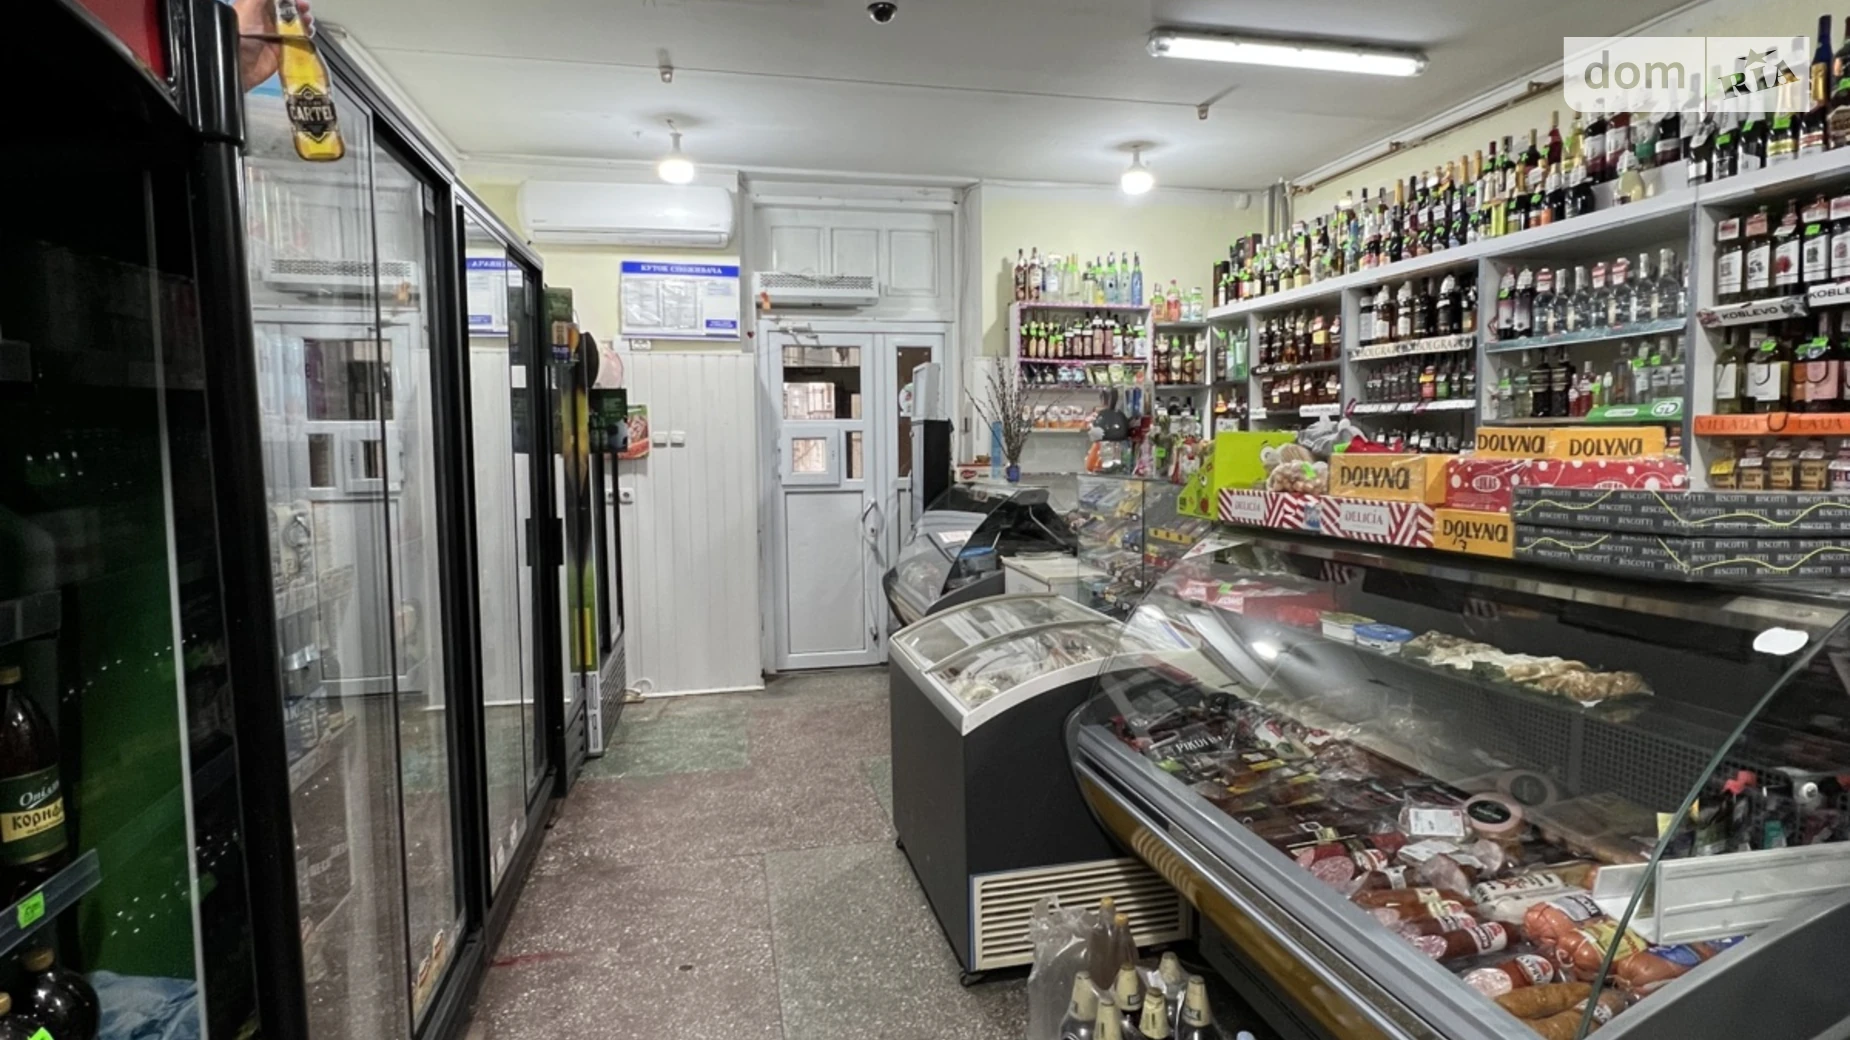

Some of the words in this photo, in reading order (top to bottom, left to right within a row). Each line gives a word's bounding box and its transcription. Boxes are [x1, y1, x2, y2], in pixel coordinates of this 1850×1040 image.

[289, 105, 334, 122] CARTEL
[641, 264, 668, 272] КУТОК
[670, 266, 722, 275] СПОЖИВАЧА
[1721, 306, 1778, 320] KOBLEVO
